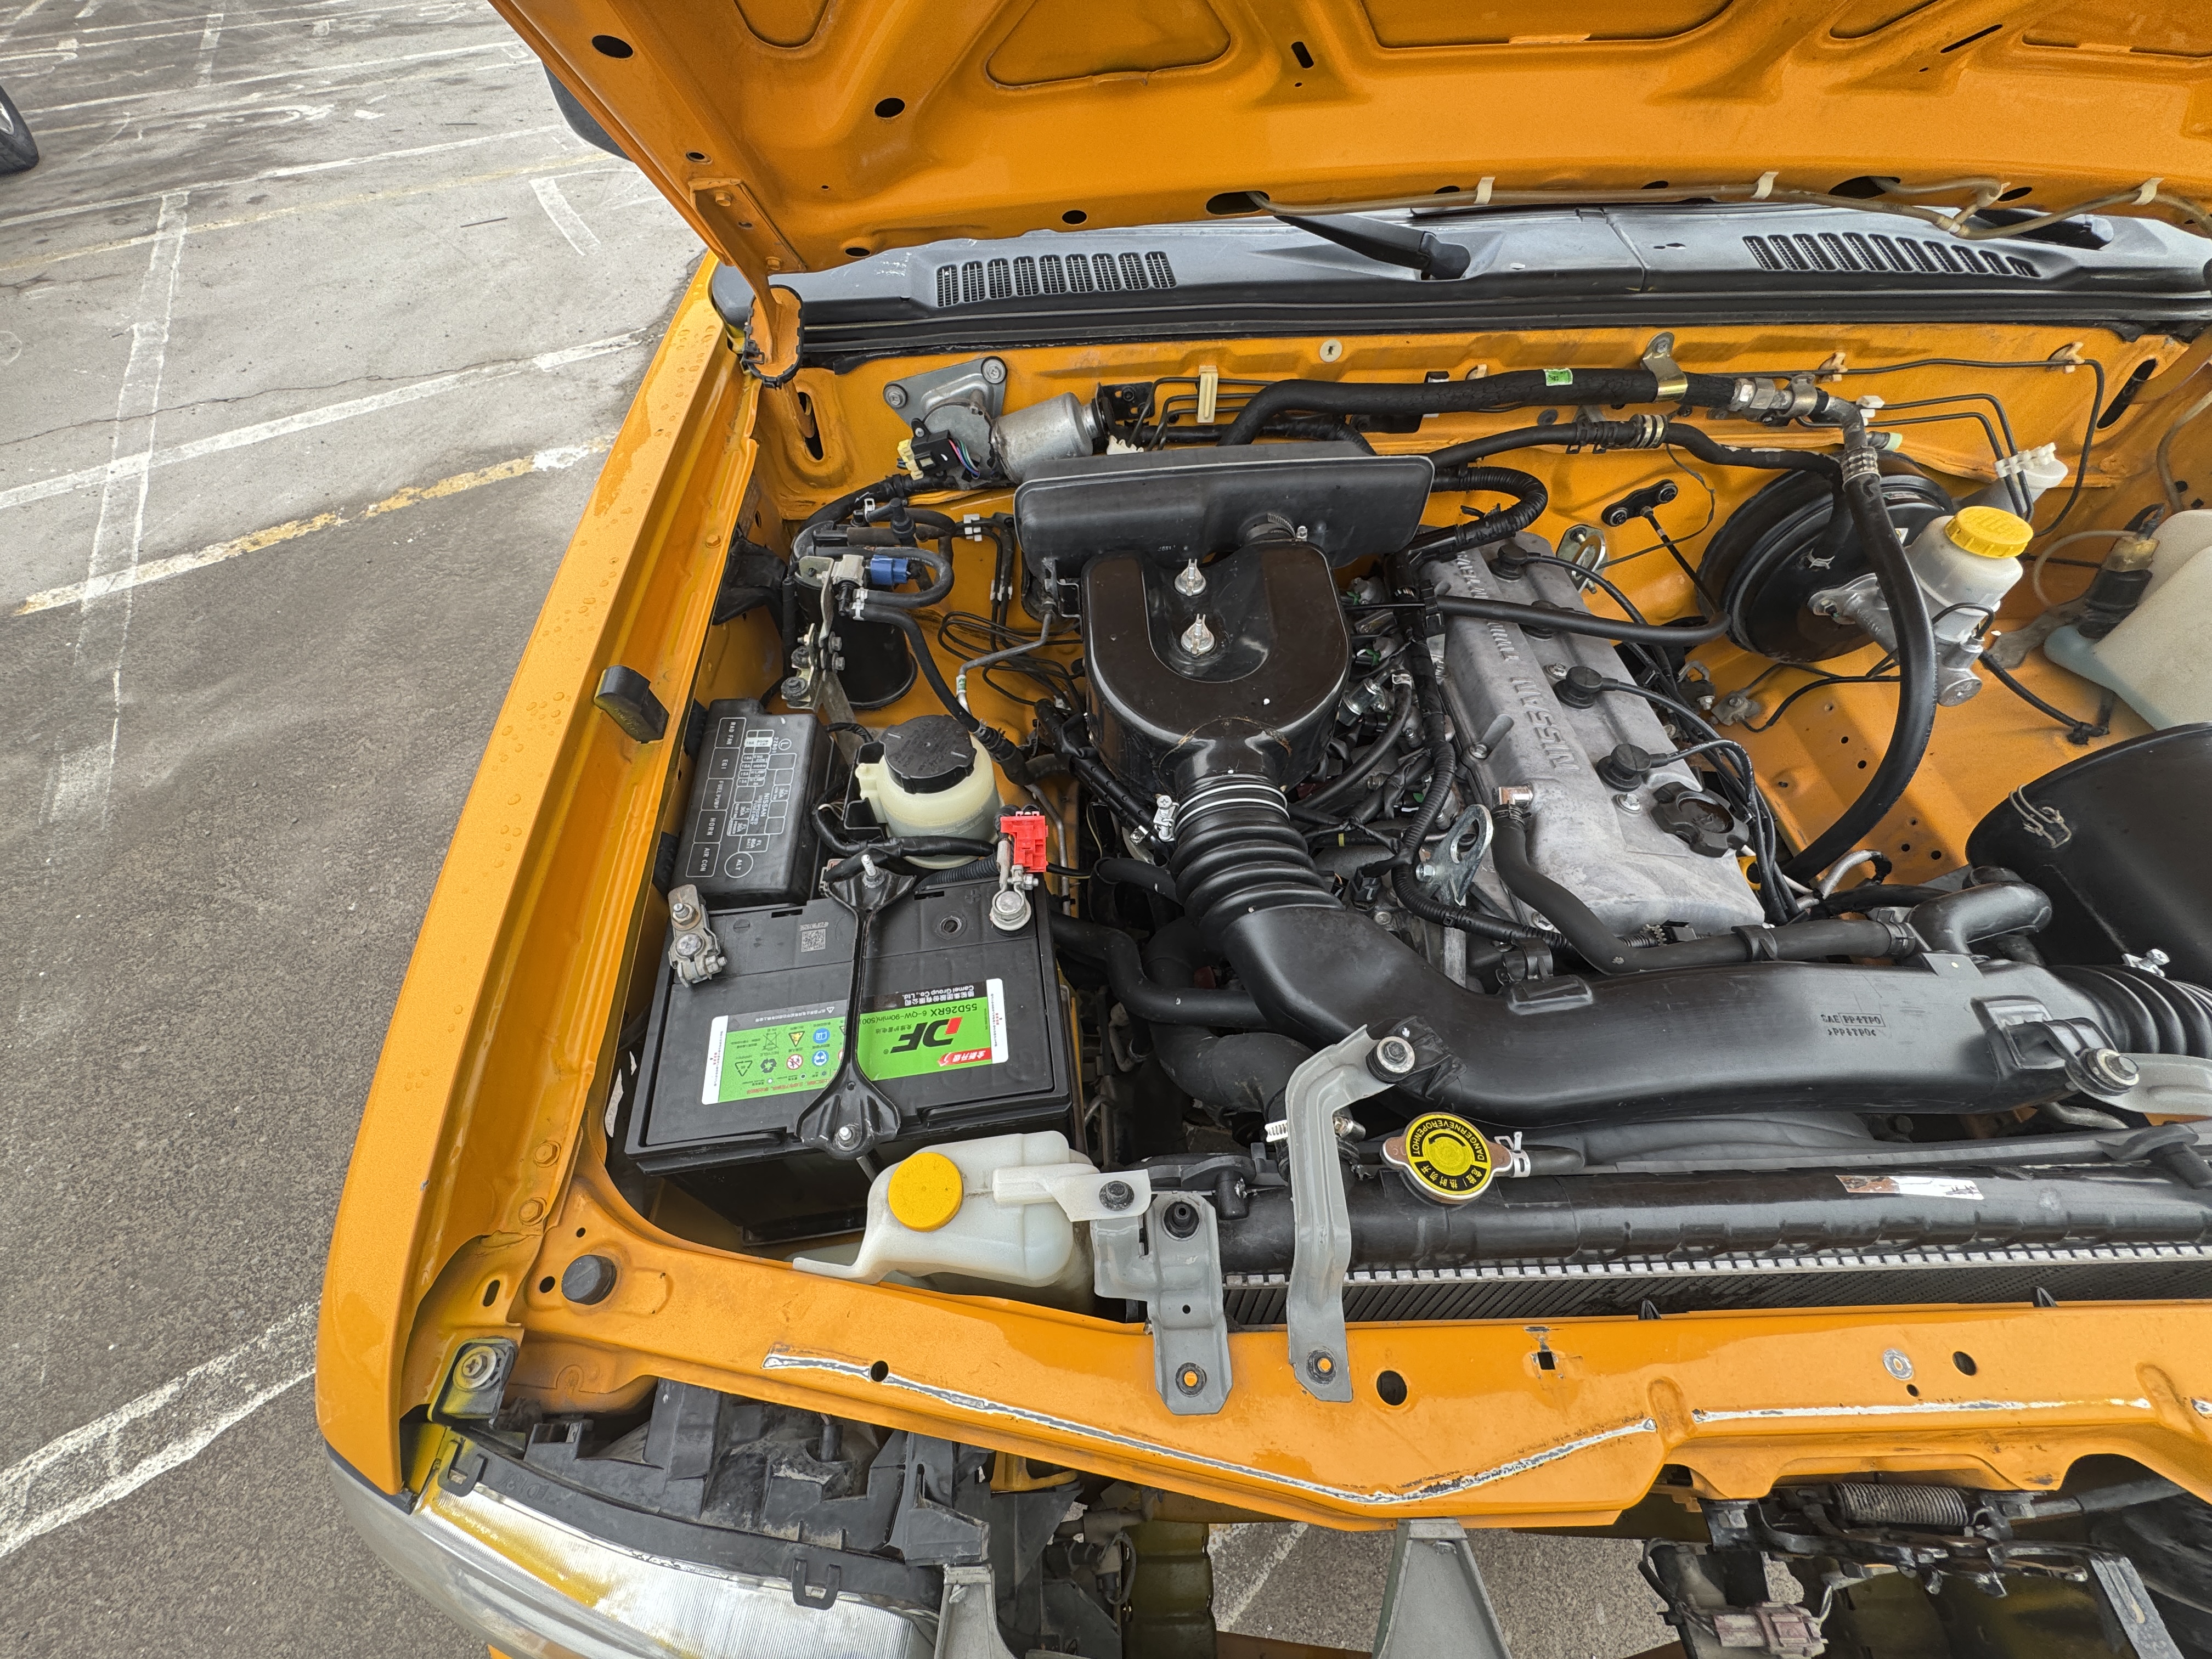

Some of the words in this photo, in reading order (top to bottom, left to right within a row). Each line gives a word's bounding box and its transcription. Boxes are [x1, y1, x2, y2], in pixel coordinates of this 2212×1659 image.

[1510, 677, 1580, 771] NISSAN
[726, 734, 734, 745] FAN
[760, 793, 770, 817] NISSAN
[707, 817, 716, 836] HORN
[699, 859, 708, 872] CON
[930, 987, 952, 995] Group
[953, 985, 974, 993] Camel
[930, 1003, 978, 1017] 55D26RX
[875, 1024, 912, 1034] 免维护蓄电池
[952, 1049, 986, 1063] 全新升级
